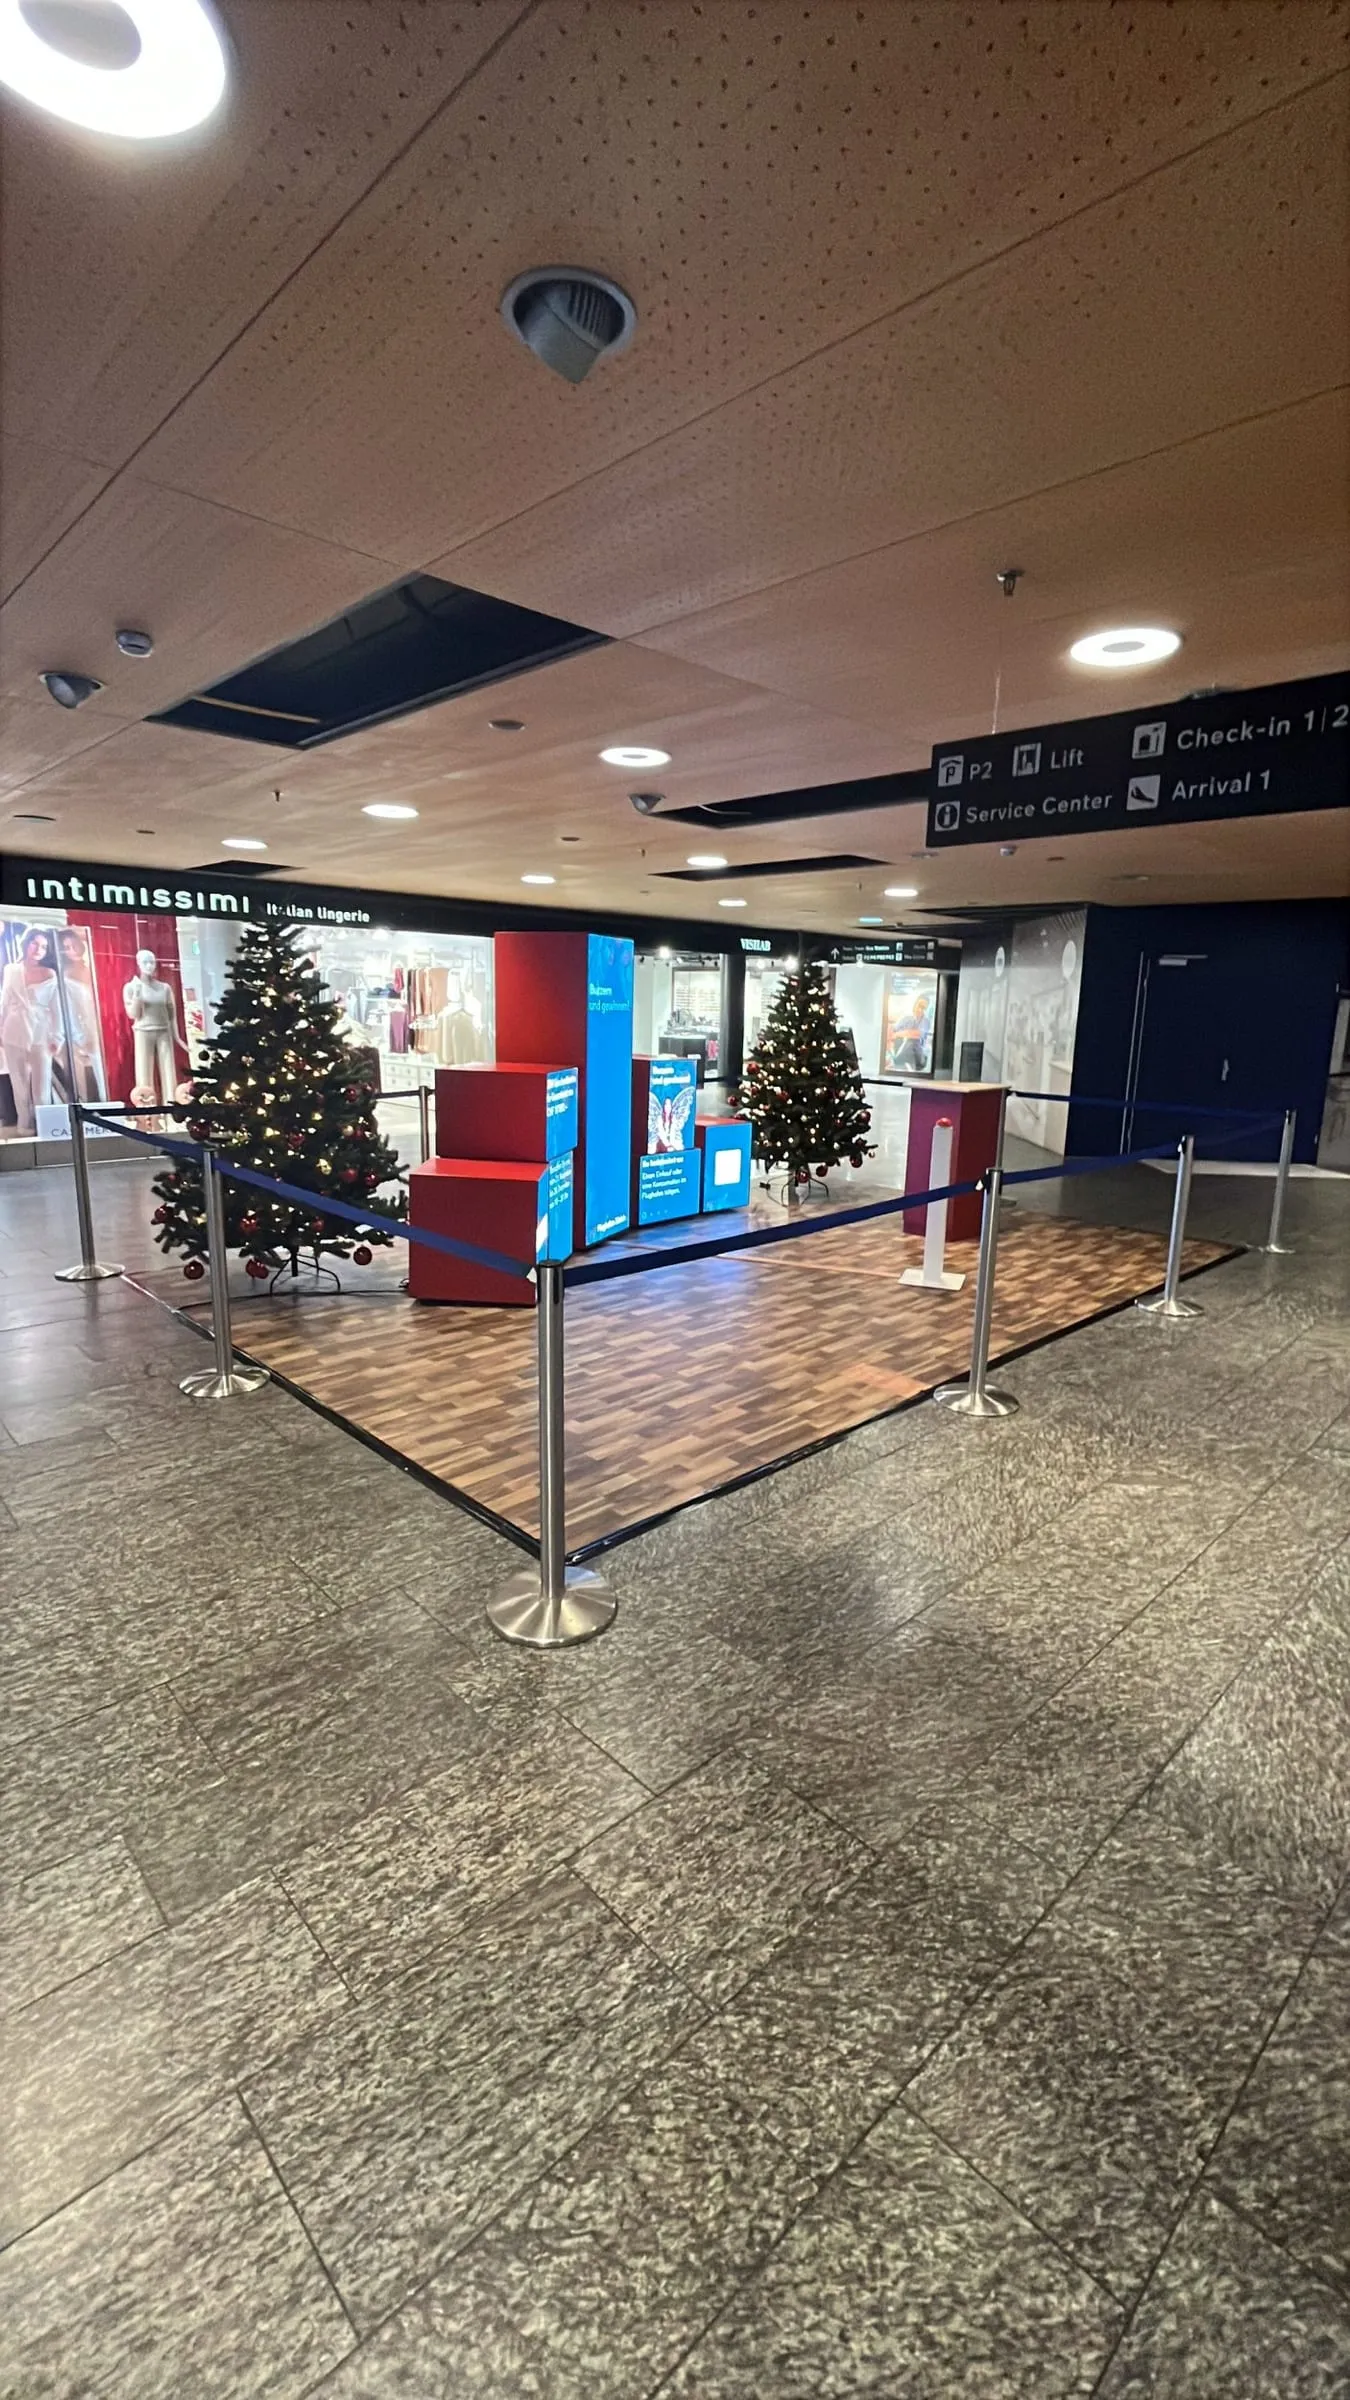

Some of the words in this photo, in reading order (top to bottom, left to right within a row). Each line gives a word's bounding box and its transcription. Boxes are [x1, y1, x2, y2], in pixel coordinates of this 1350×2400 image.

[1177, 715, 1291, 750] Check-in
[969, 761, 993, 781] P2
[1050, 748, 1084, 769] Lift
[1172, 771, 1251, 801] Arrival
[1260, 769, 1272, 790] 1
[966, 802, 1036, 824] Service
[1042, 793, 1113, 815] Center
[27, 877, 250, 914] intimissimi
